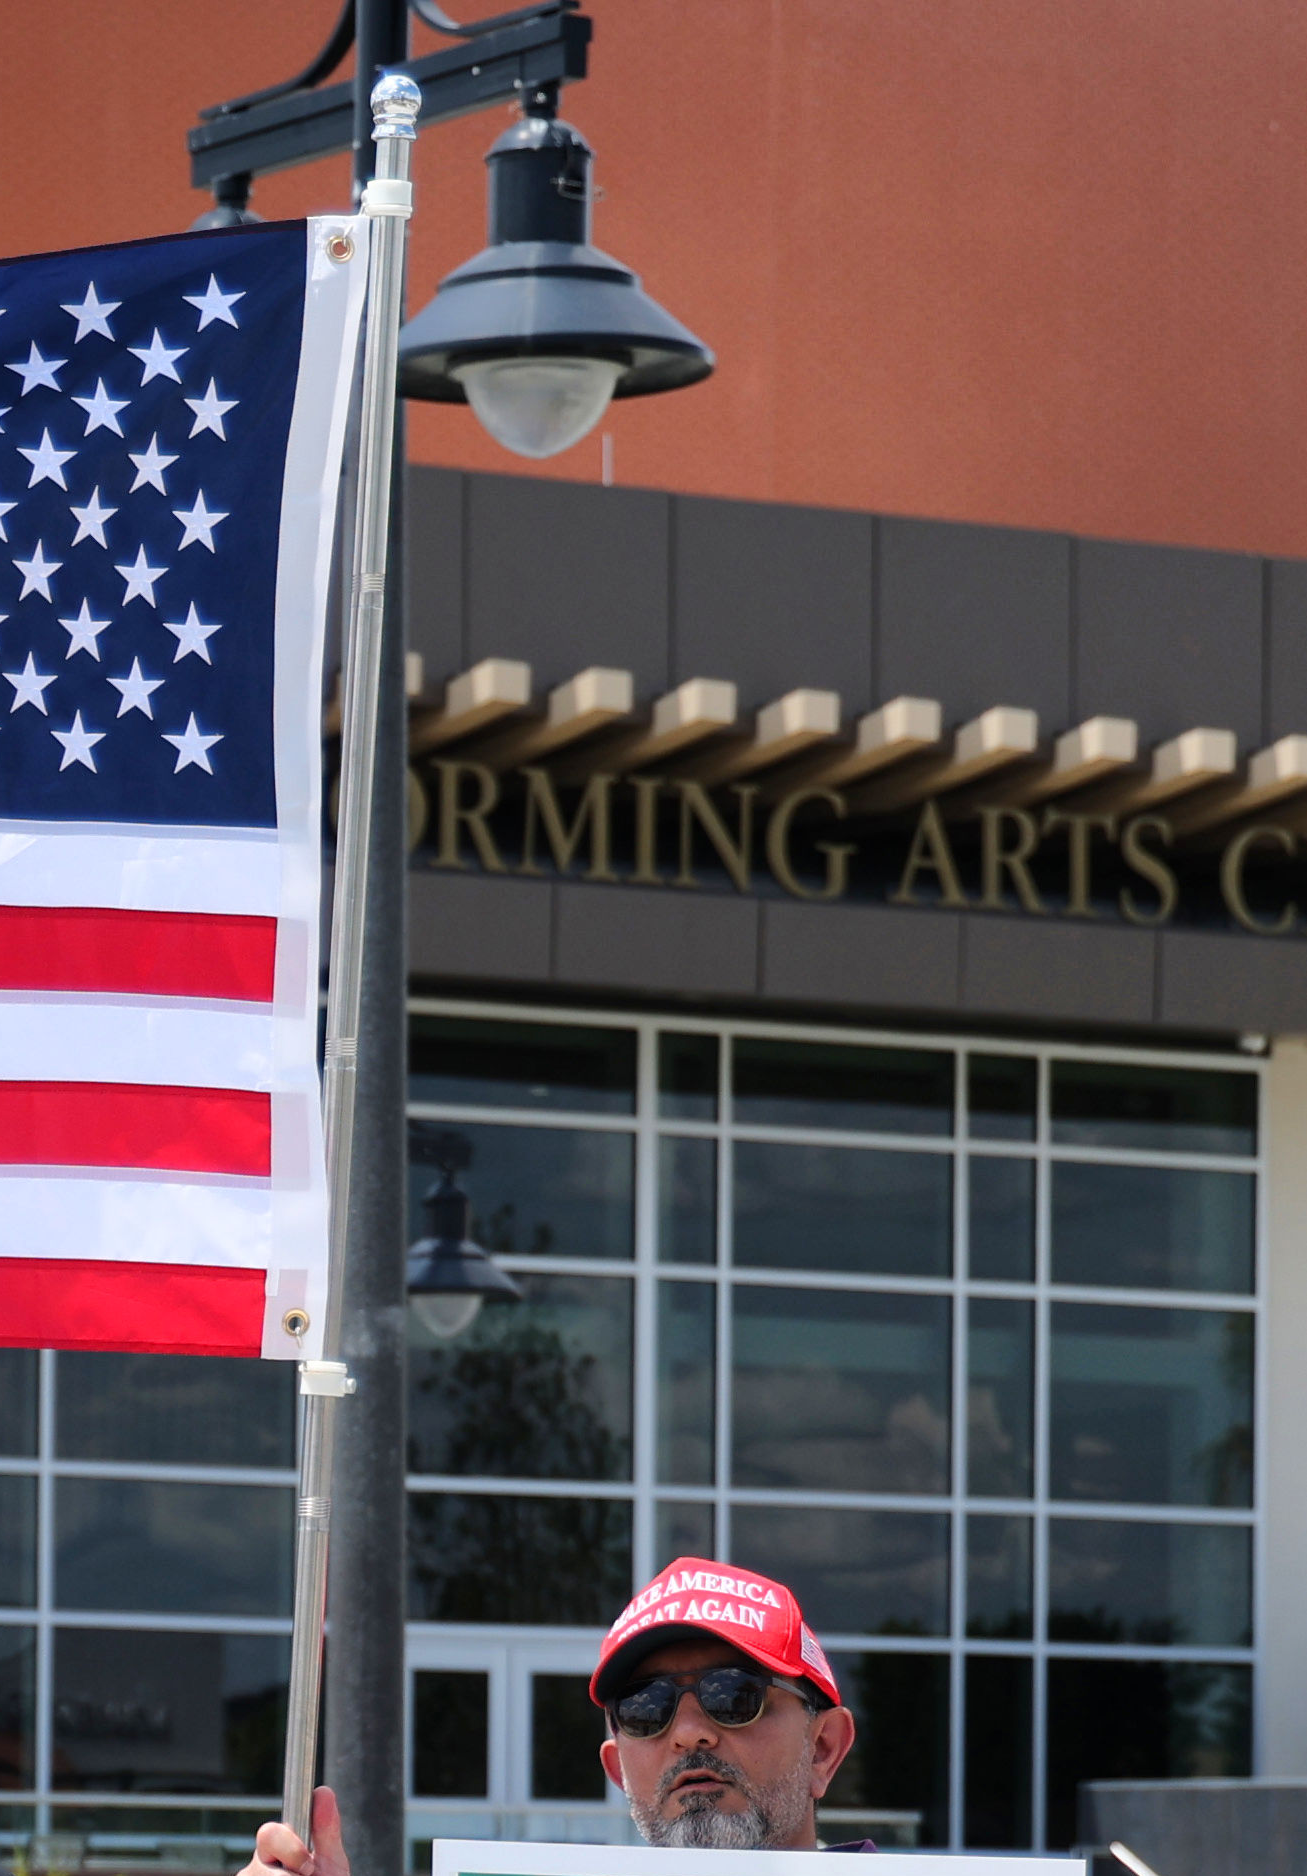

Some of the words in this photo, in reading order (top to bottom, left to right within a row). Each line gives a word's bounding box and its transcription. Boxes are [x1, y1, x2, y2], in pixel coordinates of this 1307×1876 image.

[888, 801, 1180, 928] ARTS
[607, 1582, 664, 1638] MAKE
[662, 1571, 781, 1609] AMERICA
[682, 1599, 766, 1632] AGAIN
